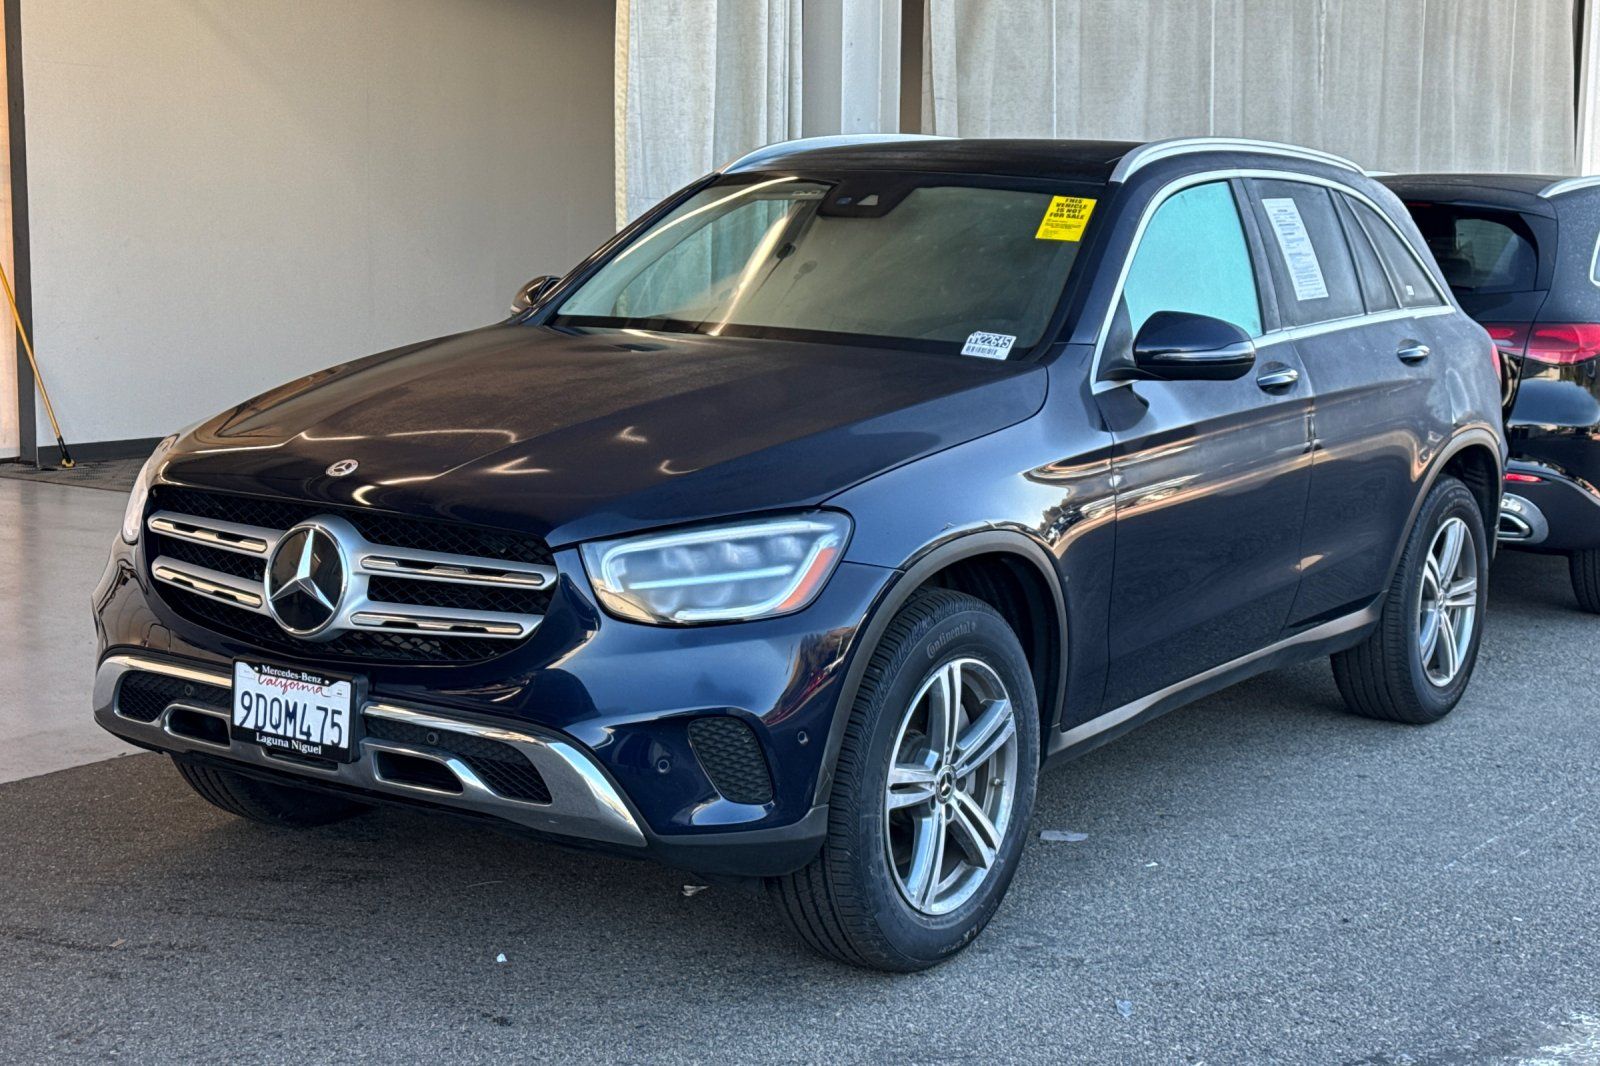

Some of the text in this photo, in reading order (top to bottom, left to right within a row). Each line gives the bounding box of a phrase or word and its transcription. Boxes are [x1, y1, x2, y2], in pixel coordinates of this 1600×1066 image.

[926, 621, 972, 659] Continental
[261, 665, 322, 684] Mercedes-Benz
[239, 690, 343, 746] 9DQM475
[256, 732, 322, 755] Laguna Niguel
